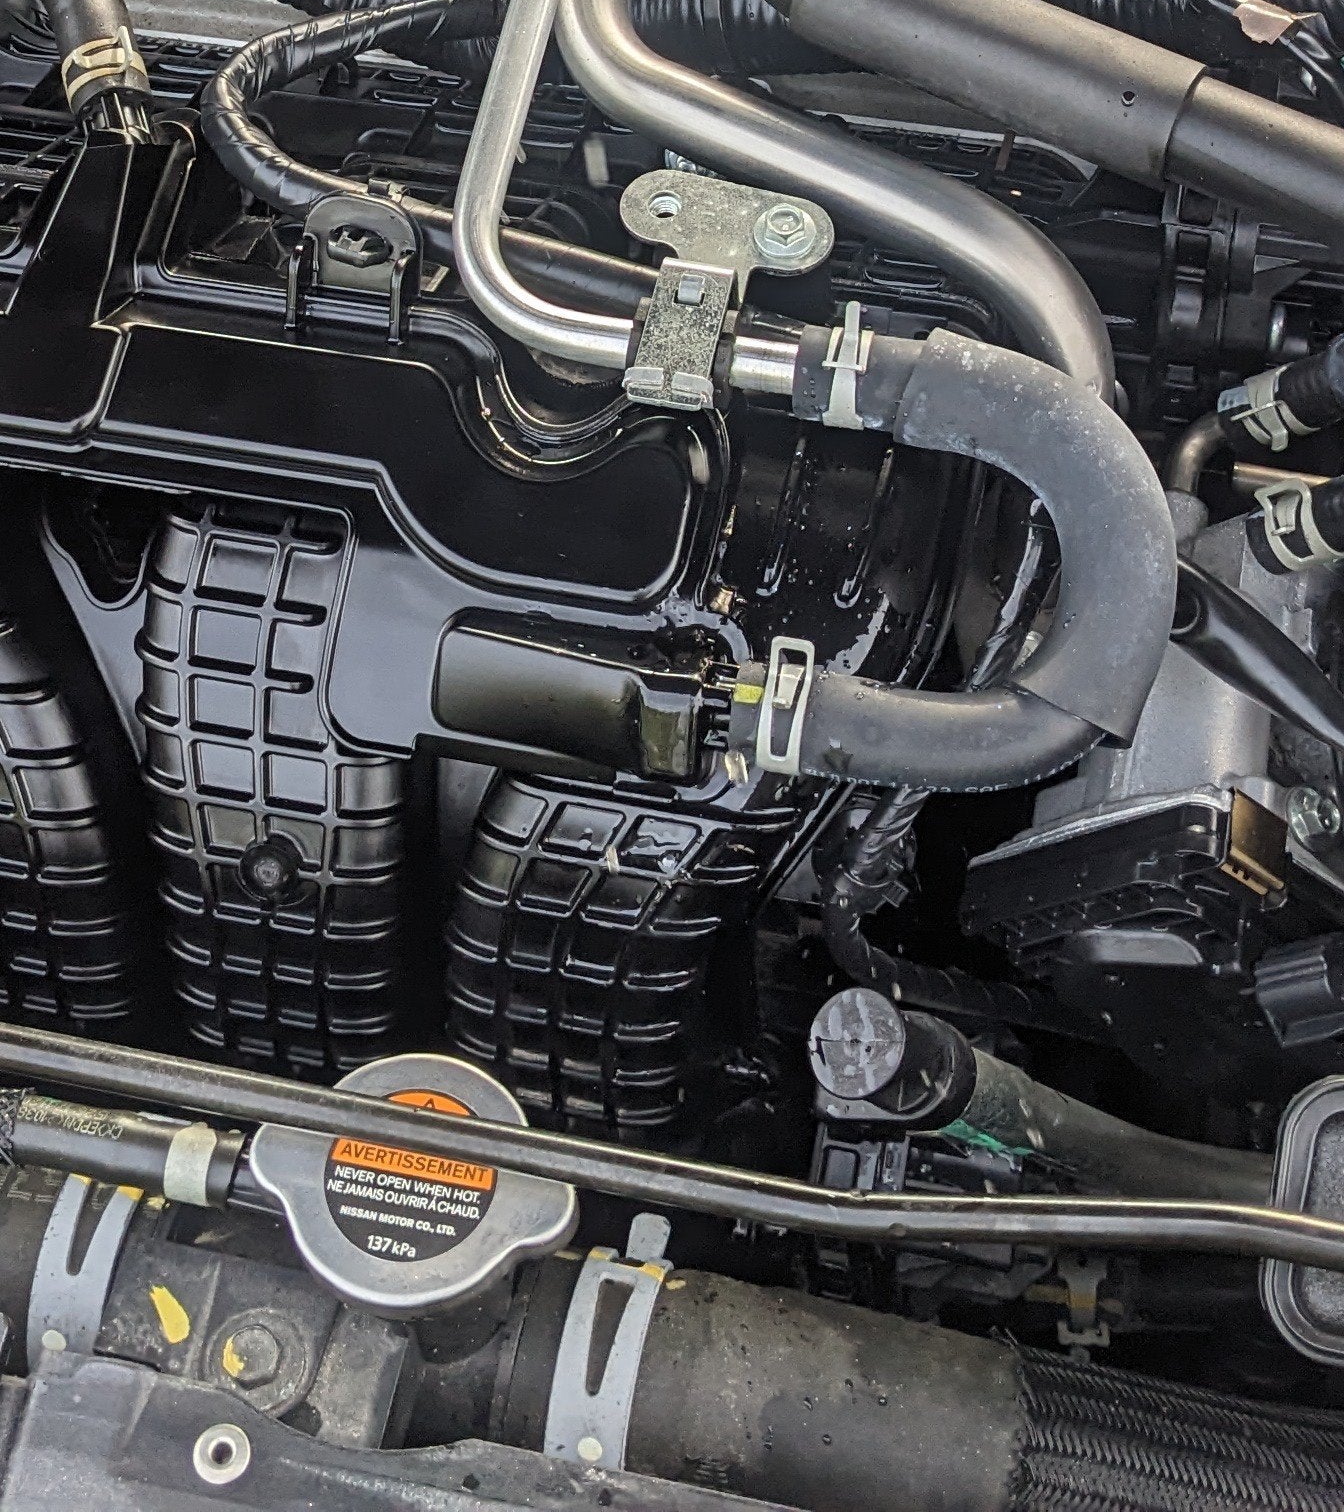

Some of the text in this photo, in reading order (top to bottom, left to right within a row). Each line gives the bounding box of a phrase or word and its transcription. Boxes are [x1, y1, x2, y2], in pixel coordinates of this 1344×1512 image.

[340, 1141, 489, 1183] AVERTISSEMENT
[326, 1178, 343, 1192] NE
[342, 1183, 384, 1202] JAMAIS
[384, 1191, 429, 1209] OUVRIR
[437, 1202, 481, 1220] CHAUD.
[334, 1164, 481, 1204] NEVER OPEN WHEN HOT.
[339, 1204, 457, 1237] NISSAN MOTOR CO., LTD.
[367, 1234, 417, 1259] 137 kPa
